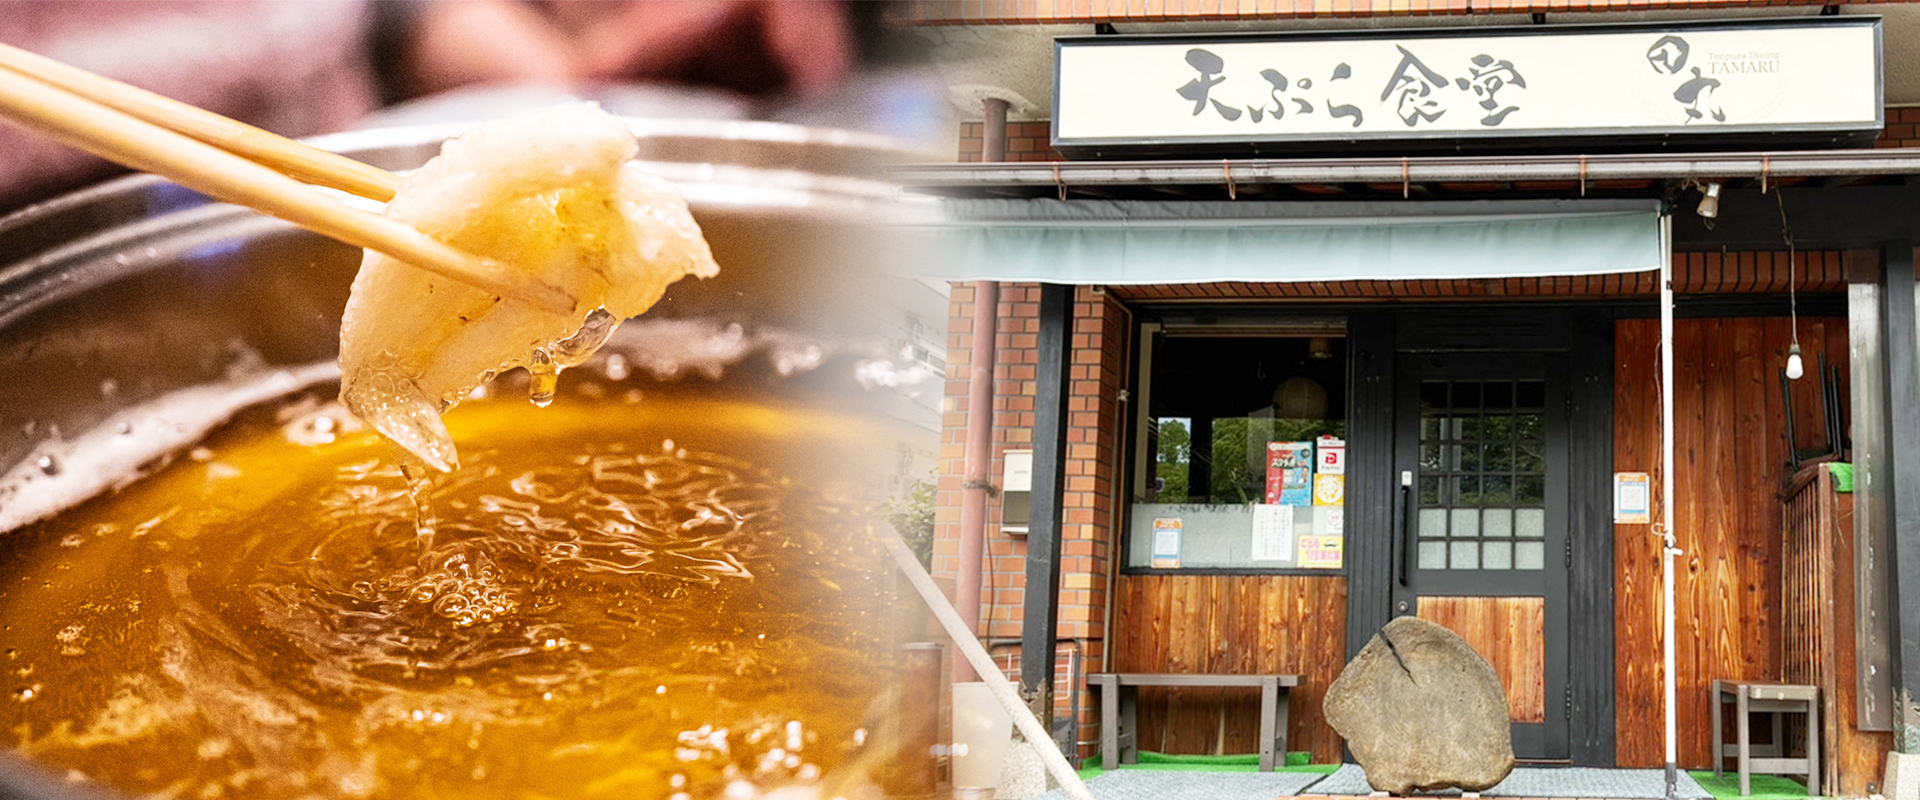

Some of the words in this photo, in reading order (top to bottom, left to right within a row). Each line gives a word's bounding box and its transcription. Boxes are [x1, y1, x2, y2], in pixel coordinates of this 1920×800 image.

[1646, 35, 1726, 124] 田丸
[1707, 60, 1780, 75] TAMARU
[1749, 51, 1780, 60] Dining
[1176, 44, 1526, 127] 天ぷら食堂
